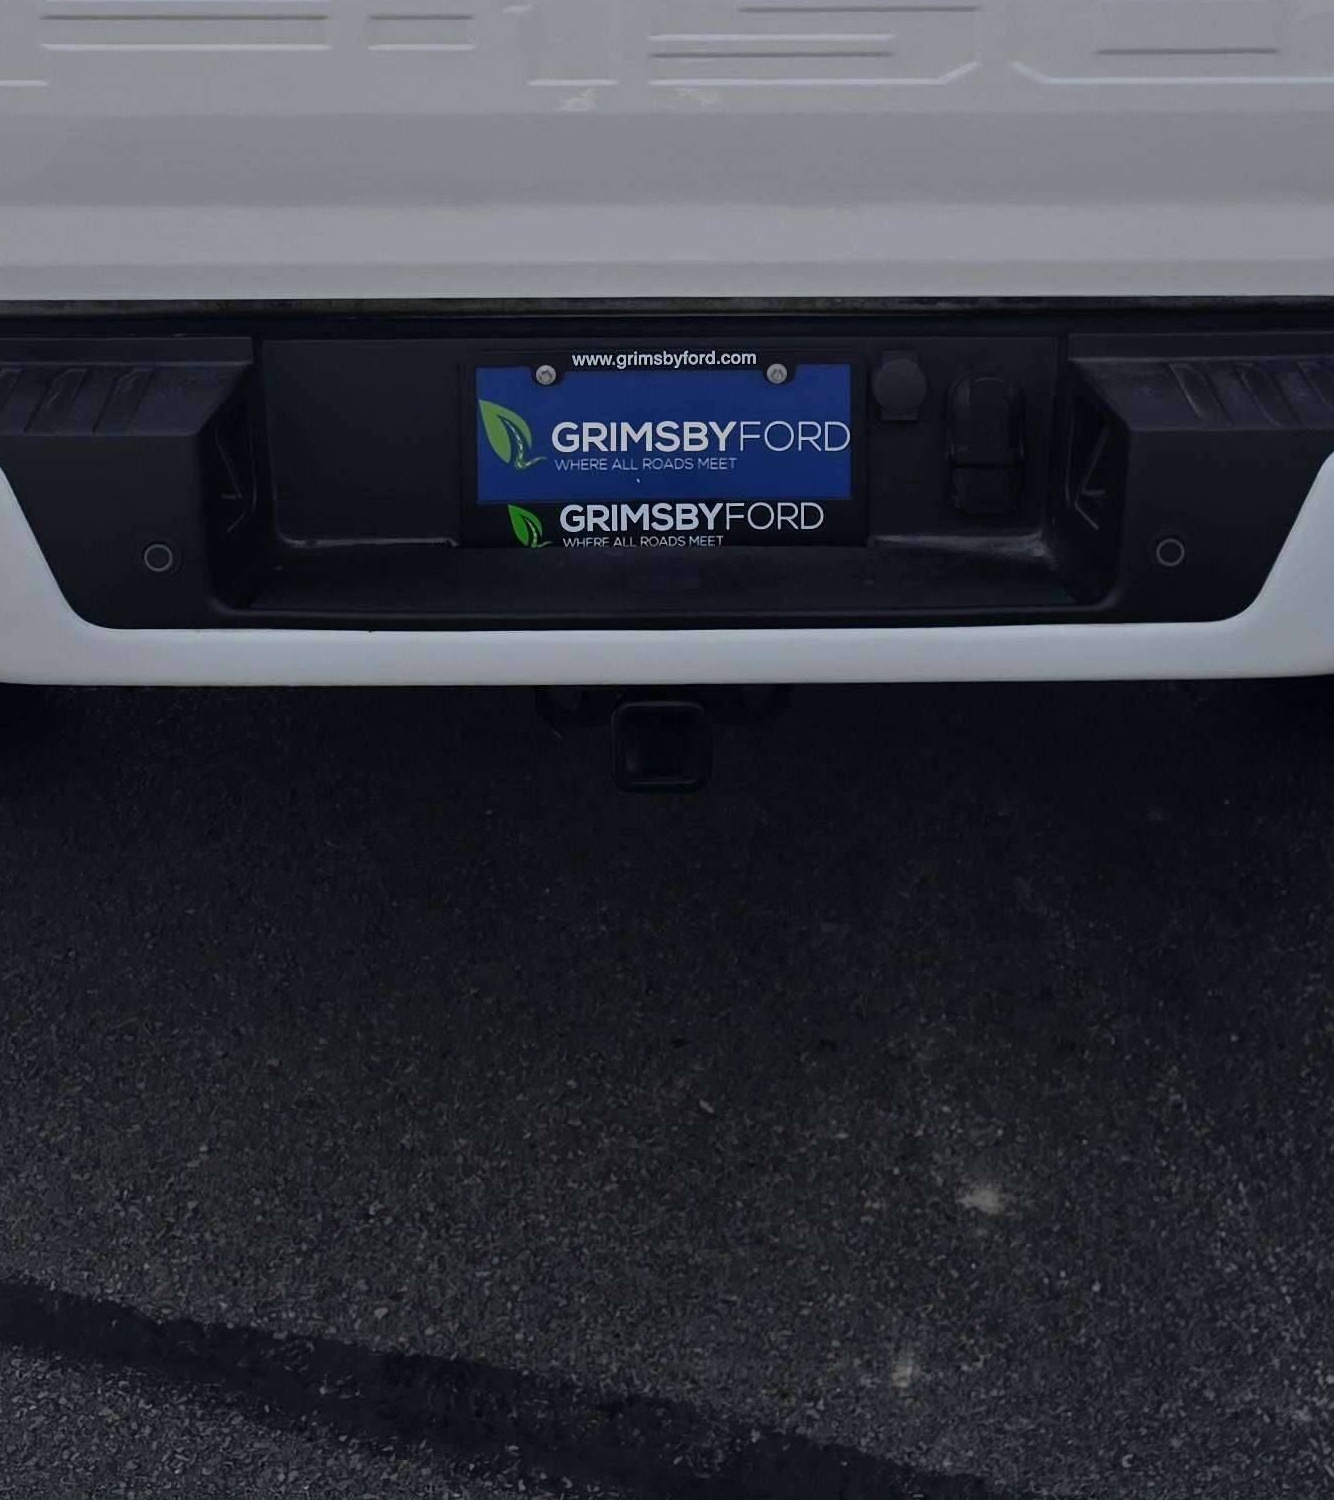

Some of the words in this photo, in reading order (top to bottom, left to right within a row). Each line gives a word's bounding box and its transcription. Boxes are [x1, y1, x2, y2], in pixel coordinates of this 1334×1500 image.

[571, 350, 757, 369] www.grimsbyford.com
[551, 419, 851, 453] GRIMSBYFORD
[554, 458, 608, 471] WHERE
[611, 457, 638, 471] ALL
[642, 457, 694, 470] ROADS
[697, 457, 738, 470] MEET
[559, 501, 824, 533] GRIMSBYFORD
[562, 536, 610, 547] WHERE
[613, 536, 638, 547] ALL
[640, 535, 686, 547] ROADS
[688, 535, 724, 547] MEET
